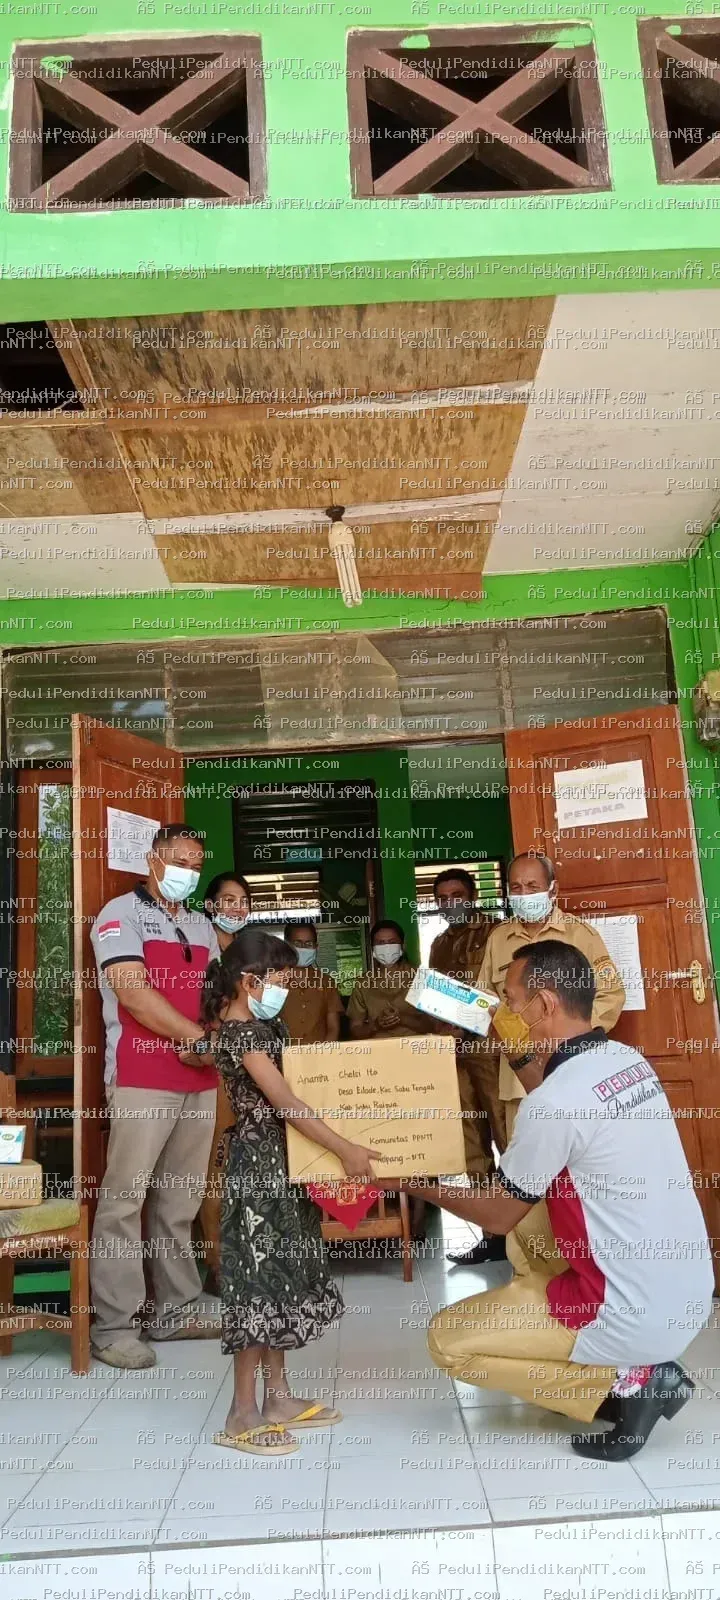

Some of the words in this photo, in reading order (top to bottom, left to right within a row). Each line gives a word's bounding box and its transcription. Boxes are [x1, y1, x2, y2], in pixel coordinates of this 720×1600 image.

[596, 1061, 654, 1099] PEDUL
[369, 1135, 409, 1145] Komunitas
[377, 1154, 404, 1166] upang
